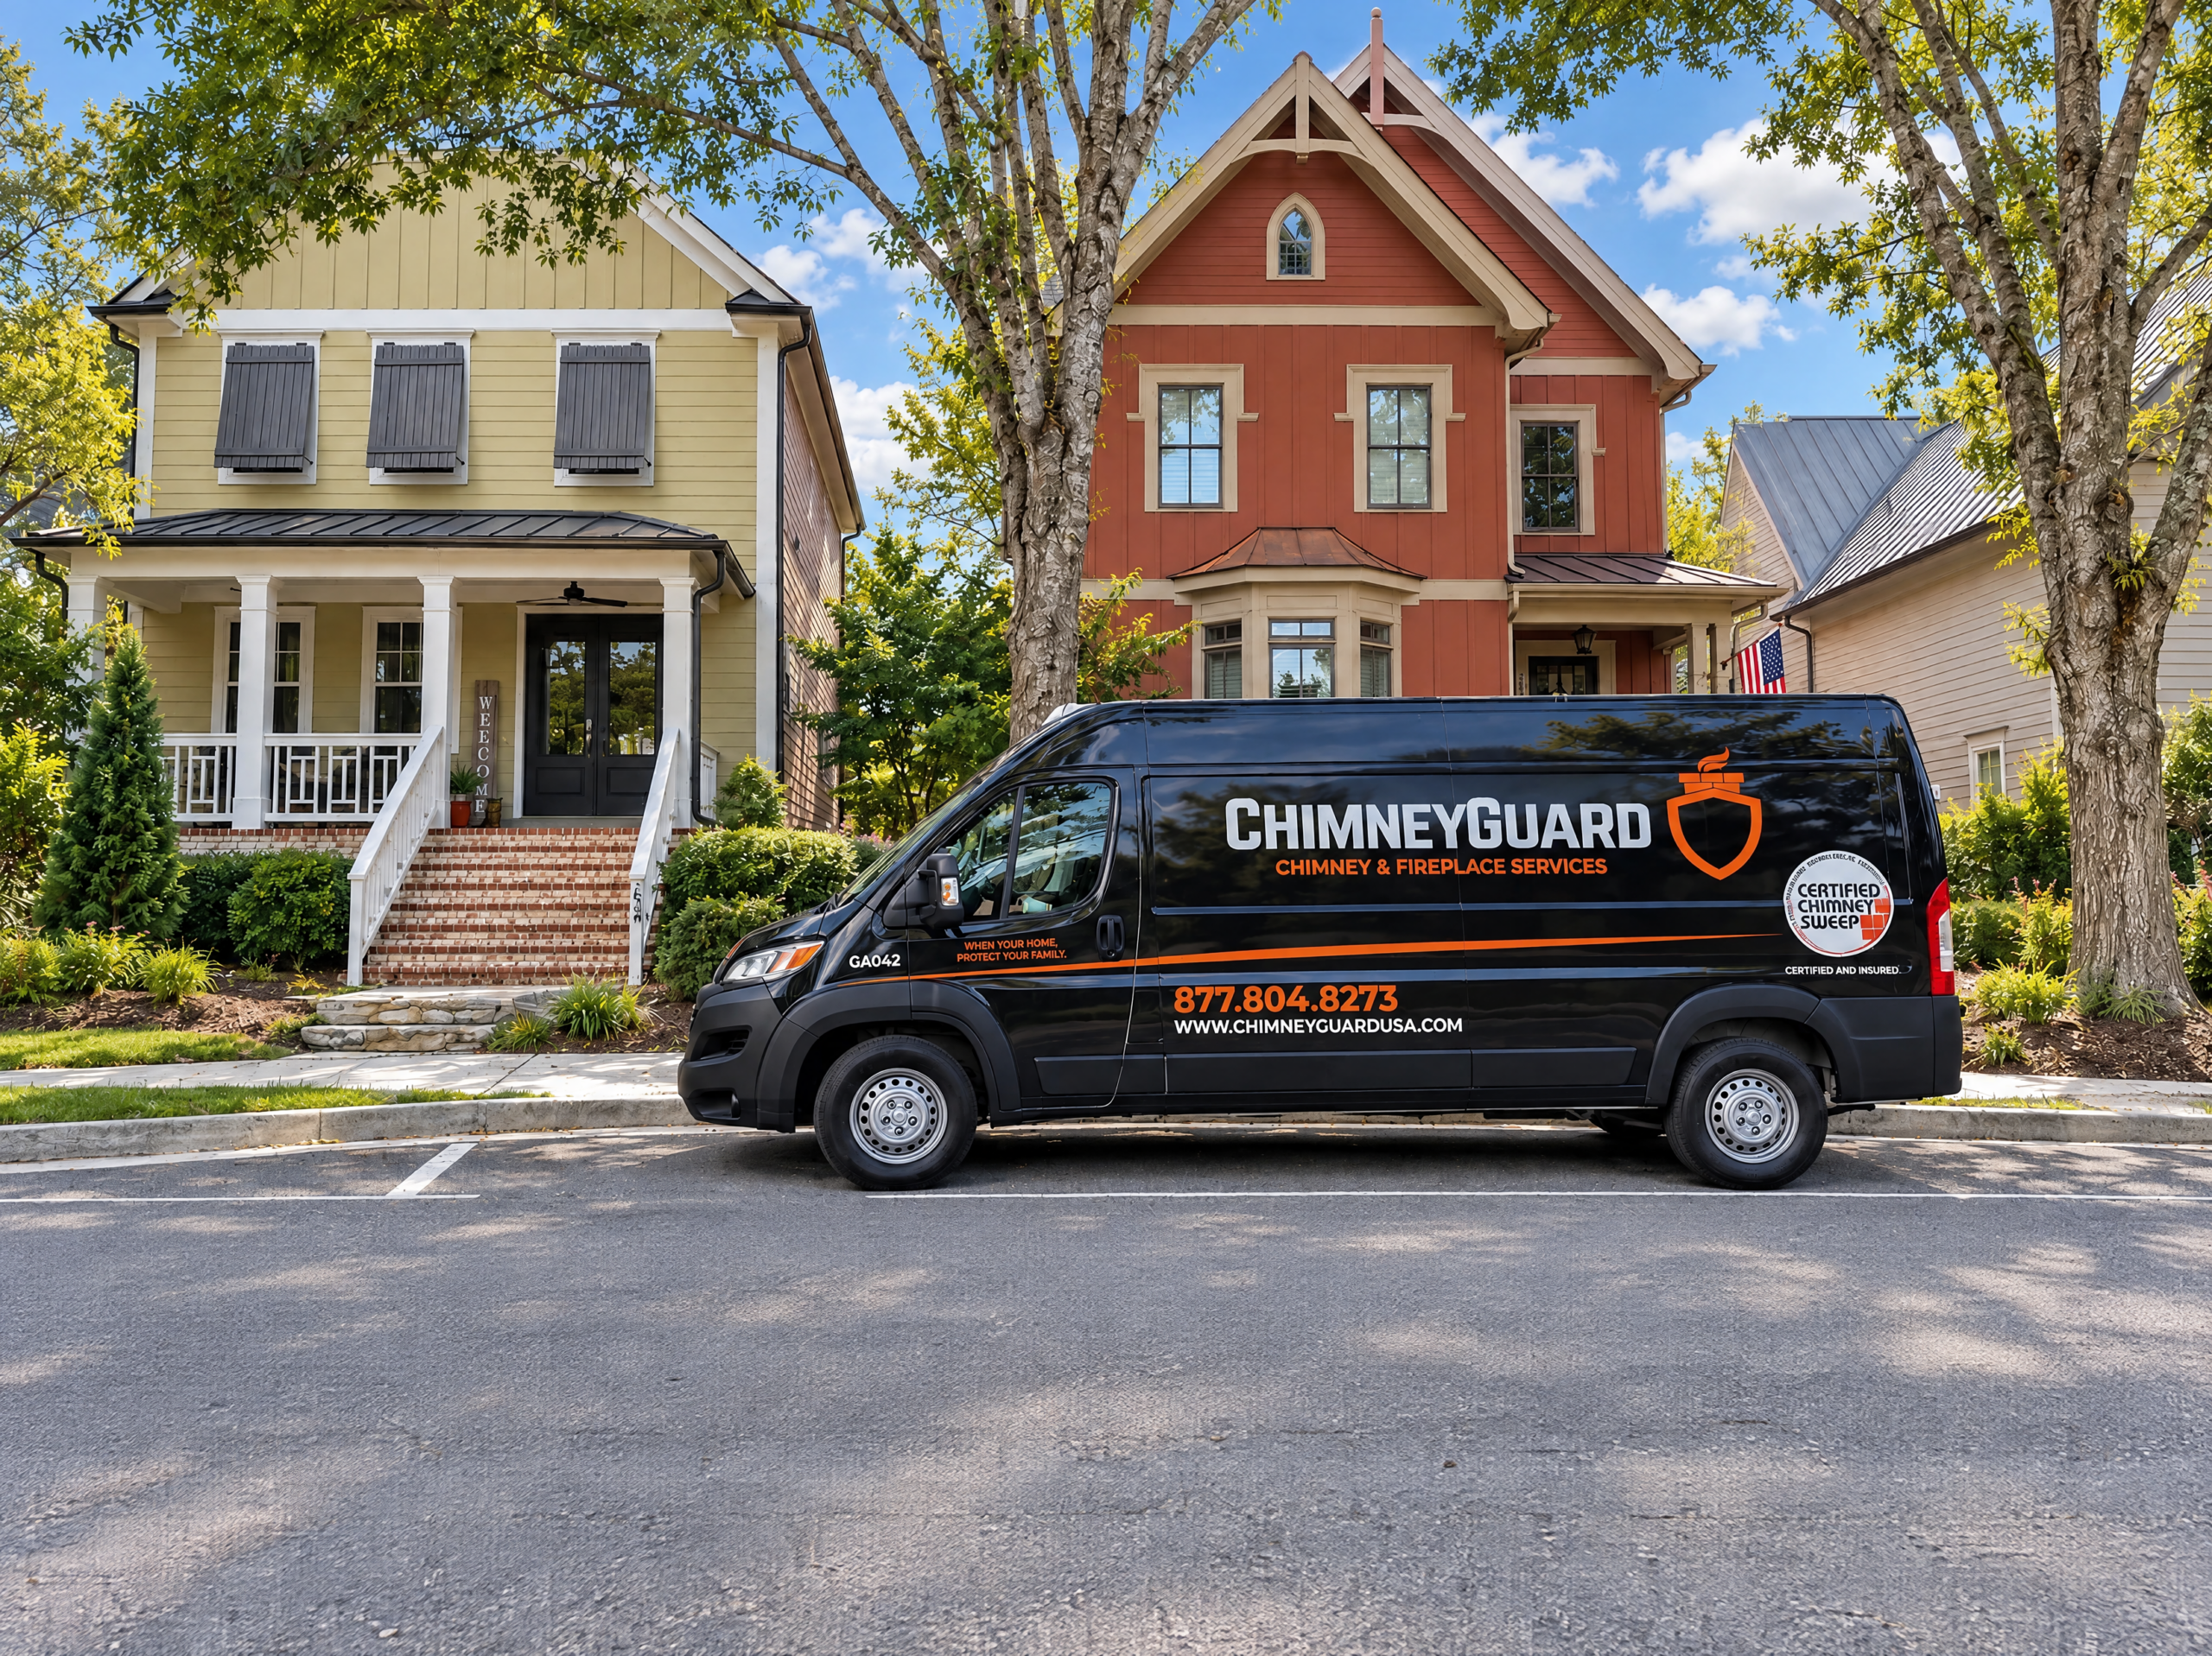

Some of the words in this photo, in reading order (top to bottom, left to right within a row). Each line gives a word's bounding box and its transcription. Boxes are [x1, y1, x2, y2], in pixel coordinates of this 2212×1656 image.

[1275, 859, 1372, 876] CHIMNEY
[1376, 859, 1391, 875] &
[1396, 858, 1506, 875] FIREPLACE
[1510, 858, 1608, 875] SERVICES
[1797, 883, 1881, 898] CERTIFIED
[1797, 899, 1874, 915] CHIMNEY
[1800, 915, 1859, 930] SWEEP
[963, 941, 995, 951] WHEN
[996, 939, 1025, 949] YOUR
[1027, 937, 1058, 949] HOME,
[849, 953, 901, 968] GA042
[957, 952, 1001, 962] PROTECT
[1002, 951, 1029, 961] YOUR
[1031, 949, 1067, 960] FAMILY.
[1784, 966, 1834, 975] CERTIFIED
[1835, 966, 1857, 975] AND
[1173, 985, 1398, 1013] 877.804.8273
[1173, 1017, 1463, 1035] WWW.CHIMNEYGUARDUSA.COM
